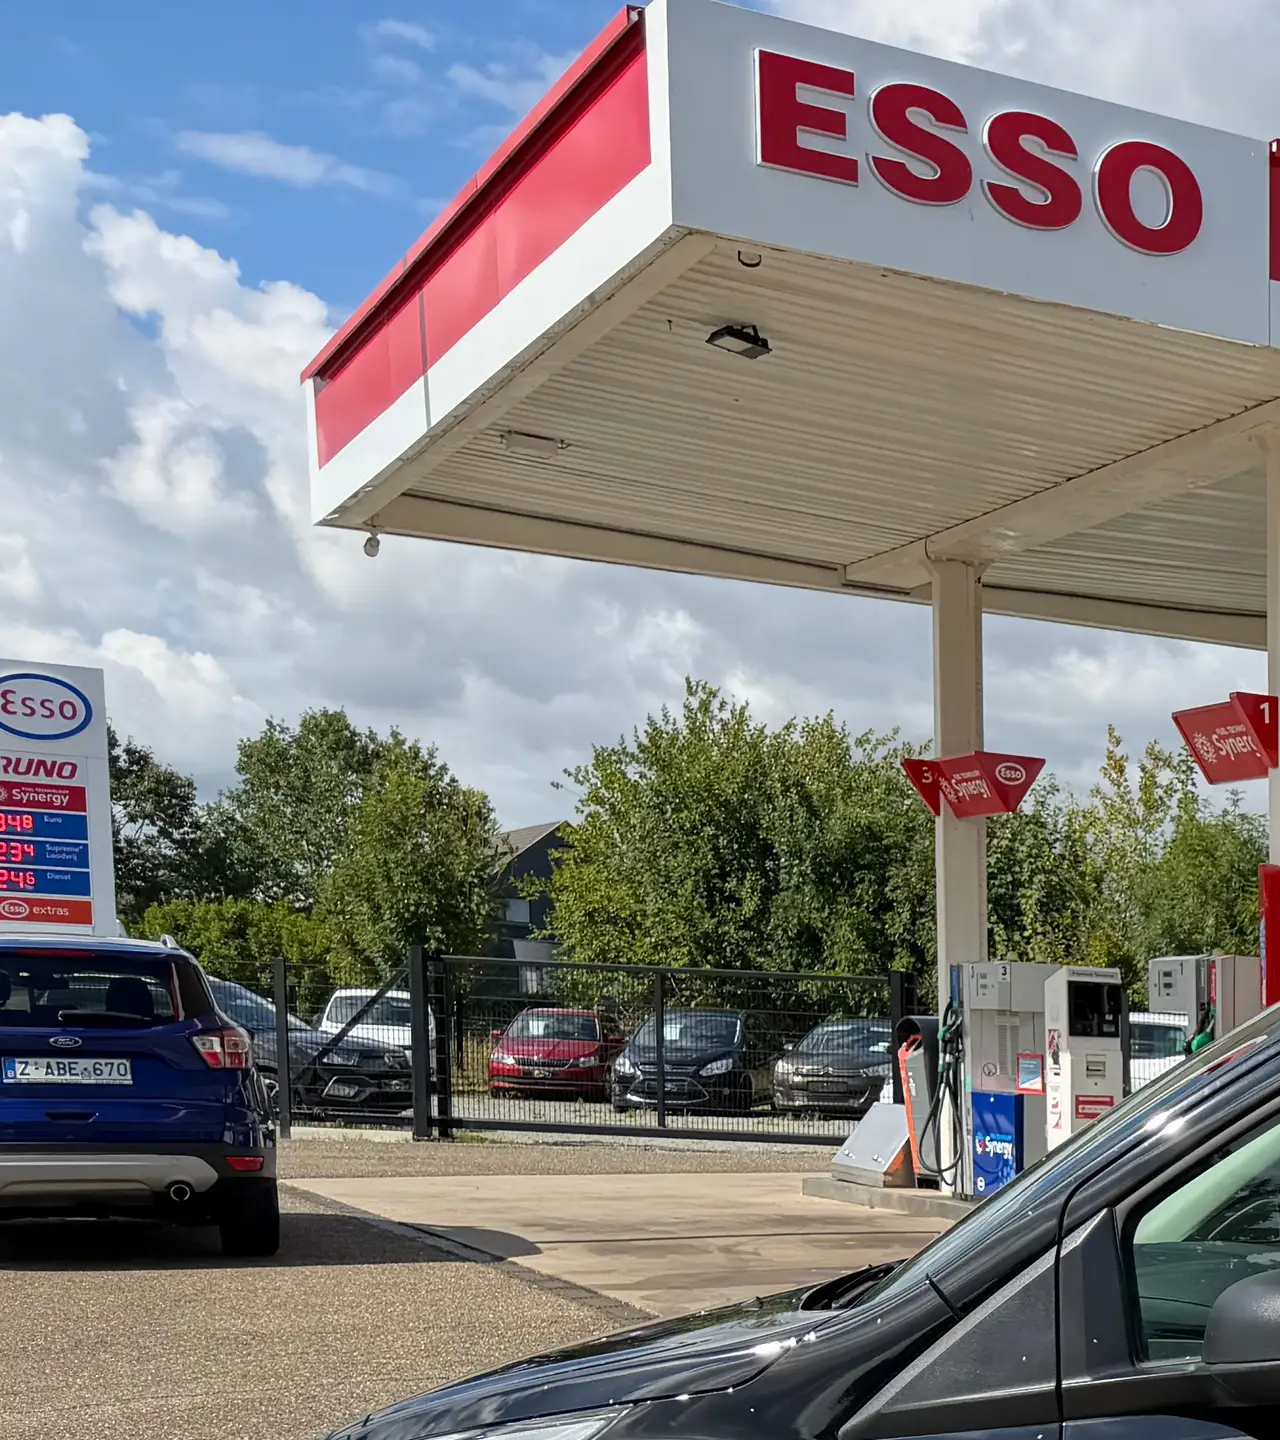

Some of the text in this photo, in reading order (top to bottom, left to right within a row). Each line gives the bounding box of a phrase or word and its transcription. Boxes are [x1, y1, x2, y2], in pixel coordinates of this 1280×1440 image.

[754, 48, 1204, 257] ESSO
[1260, 702, 1270, 724] 1
[922, 767, 933, 783] 3
[12, 788, 69, 806] Synergy
[951, 778, 991, 801] Synergy
[44, 815, 63, 823] Euro
[4, 904, 69, 916] Esso extras
[1001, 966, 1008, 977] 3
